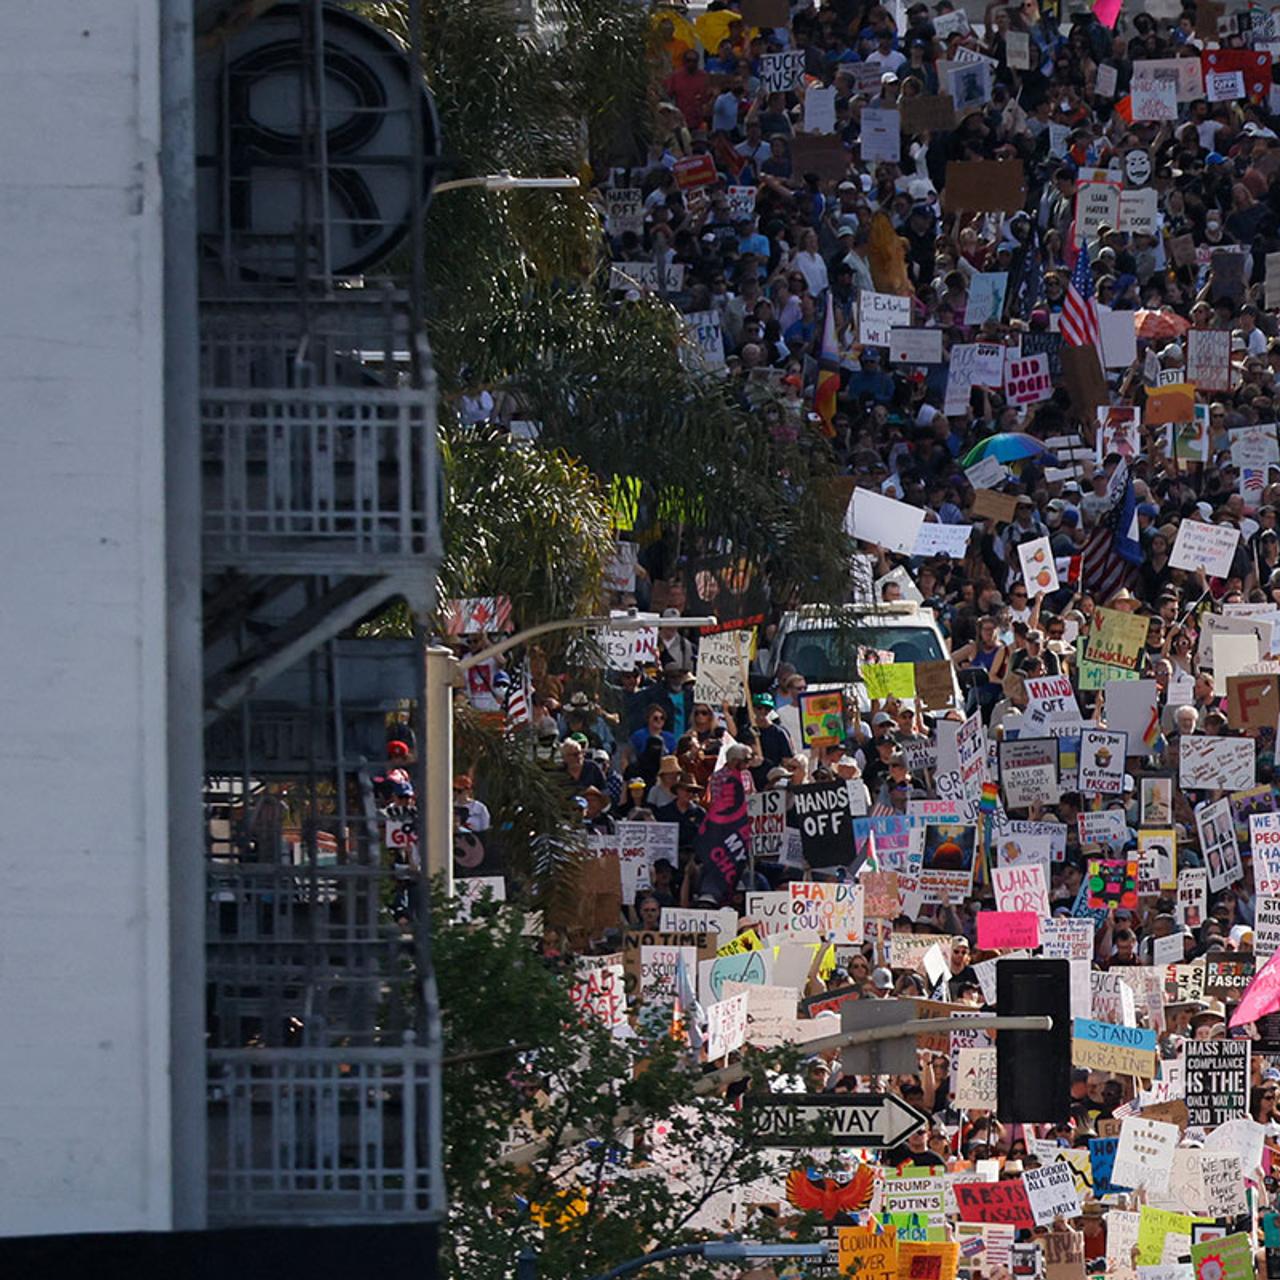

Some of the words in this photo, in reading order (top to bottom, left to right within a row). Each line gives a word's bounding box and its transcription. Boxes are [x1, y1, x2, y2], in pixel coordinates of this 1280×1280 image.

[607, 190, 642, 202] HANDS
[611, 203, 641, 216] OFF
[1011, 359, 1039, 377] BAD
[1007, 375, 1050, 395] DOGE!
[794, 786, 849, 813] HANDS
[803, 812, 843, 838] OFF
[998, 869, 1046, 893] WHAT
[999, 891, 1046, 913] CORY
[664, 914, 721, 935] Hands
[1088, 1021, 1144, 1045] STAND
[1188, 1041, 1216, 1057] MASS
[1222, 1041, 1246, 1057] NON
[1077, 1051, 1152, 1075] UKRAINE
[1188, 1057, 1245, 1072] COMPLIANCE
[1188, 1075, 1204, 1093] IS
[1210, 1074, 1243, 1092] THE
[1187, 1095, 1213, 1107] ONLY
[1215, 1094, 1234, 1106] WAY
[1236, 1094, 1245, 1106] TO
[755, 1108, 806, 1134] ONE
[821, 1108, 880, 1133] WAY
[1188, 1109, 1214, 1125] END
[1218, 1108, 1245, 1123] THIS
[887, 1179, 932, 1194] TRUMP
[888, 1197, 941, 1211] PUTIN'S
